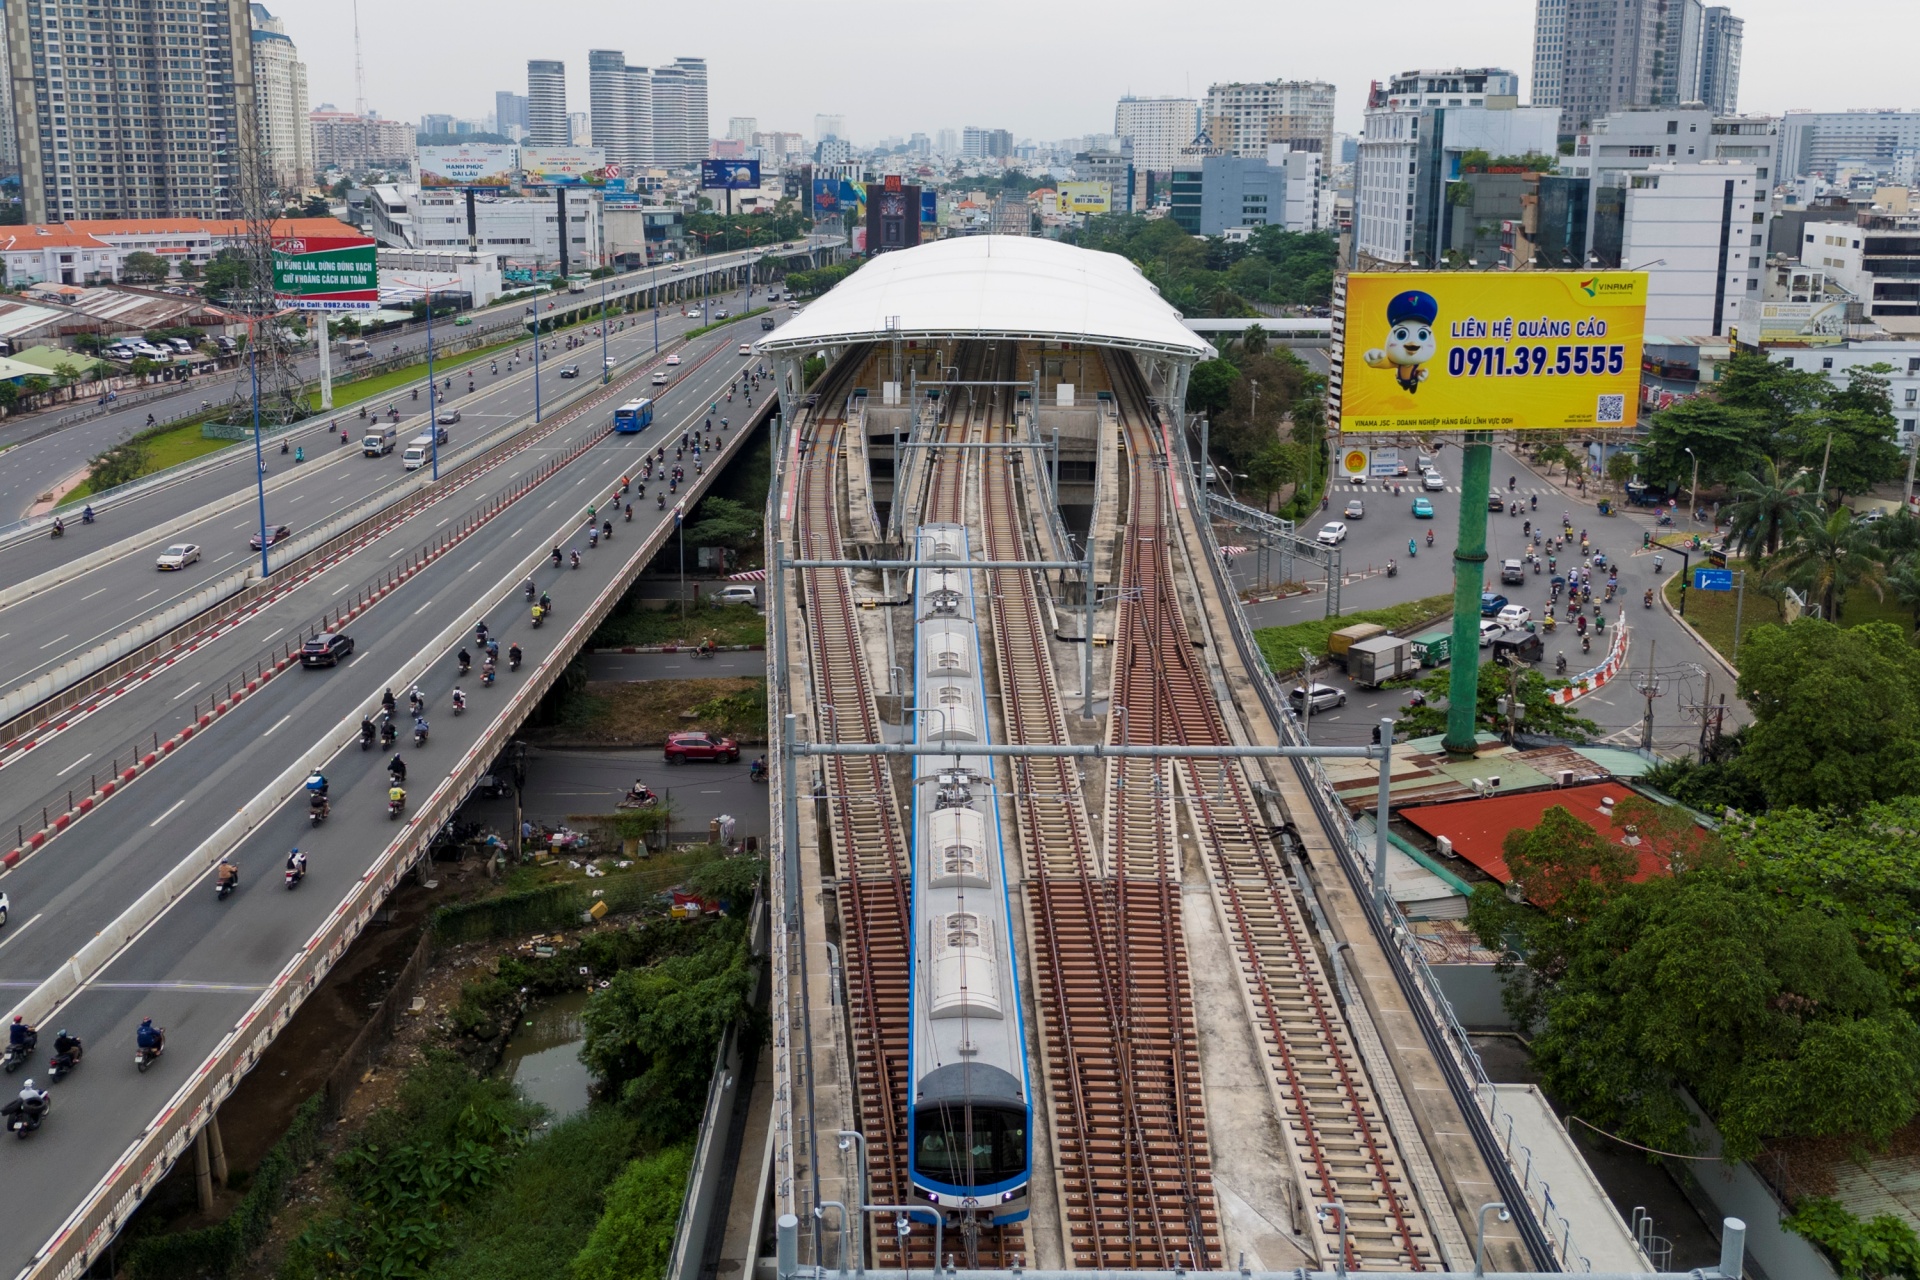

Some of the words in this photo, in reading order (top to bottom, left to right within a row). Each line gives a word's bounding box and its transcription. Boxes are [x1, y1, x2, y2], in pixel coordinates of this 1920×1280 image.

[816, 194, 836, 208] Tiger
[340, 276, 349, 284] AN
[350, 274, 366, 284] TOÀN
[1452, 317, 1487, 337] LIÊN
[1492, 317, 1513, 342] HỆ
[1517, 317, 1570, 337] QUẢNG
[1576, 317, 1606, 337] CÁO
[1448, 345, 1624, 376] 0911.39.5555
